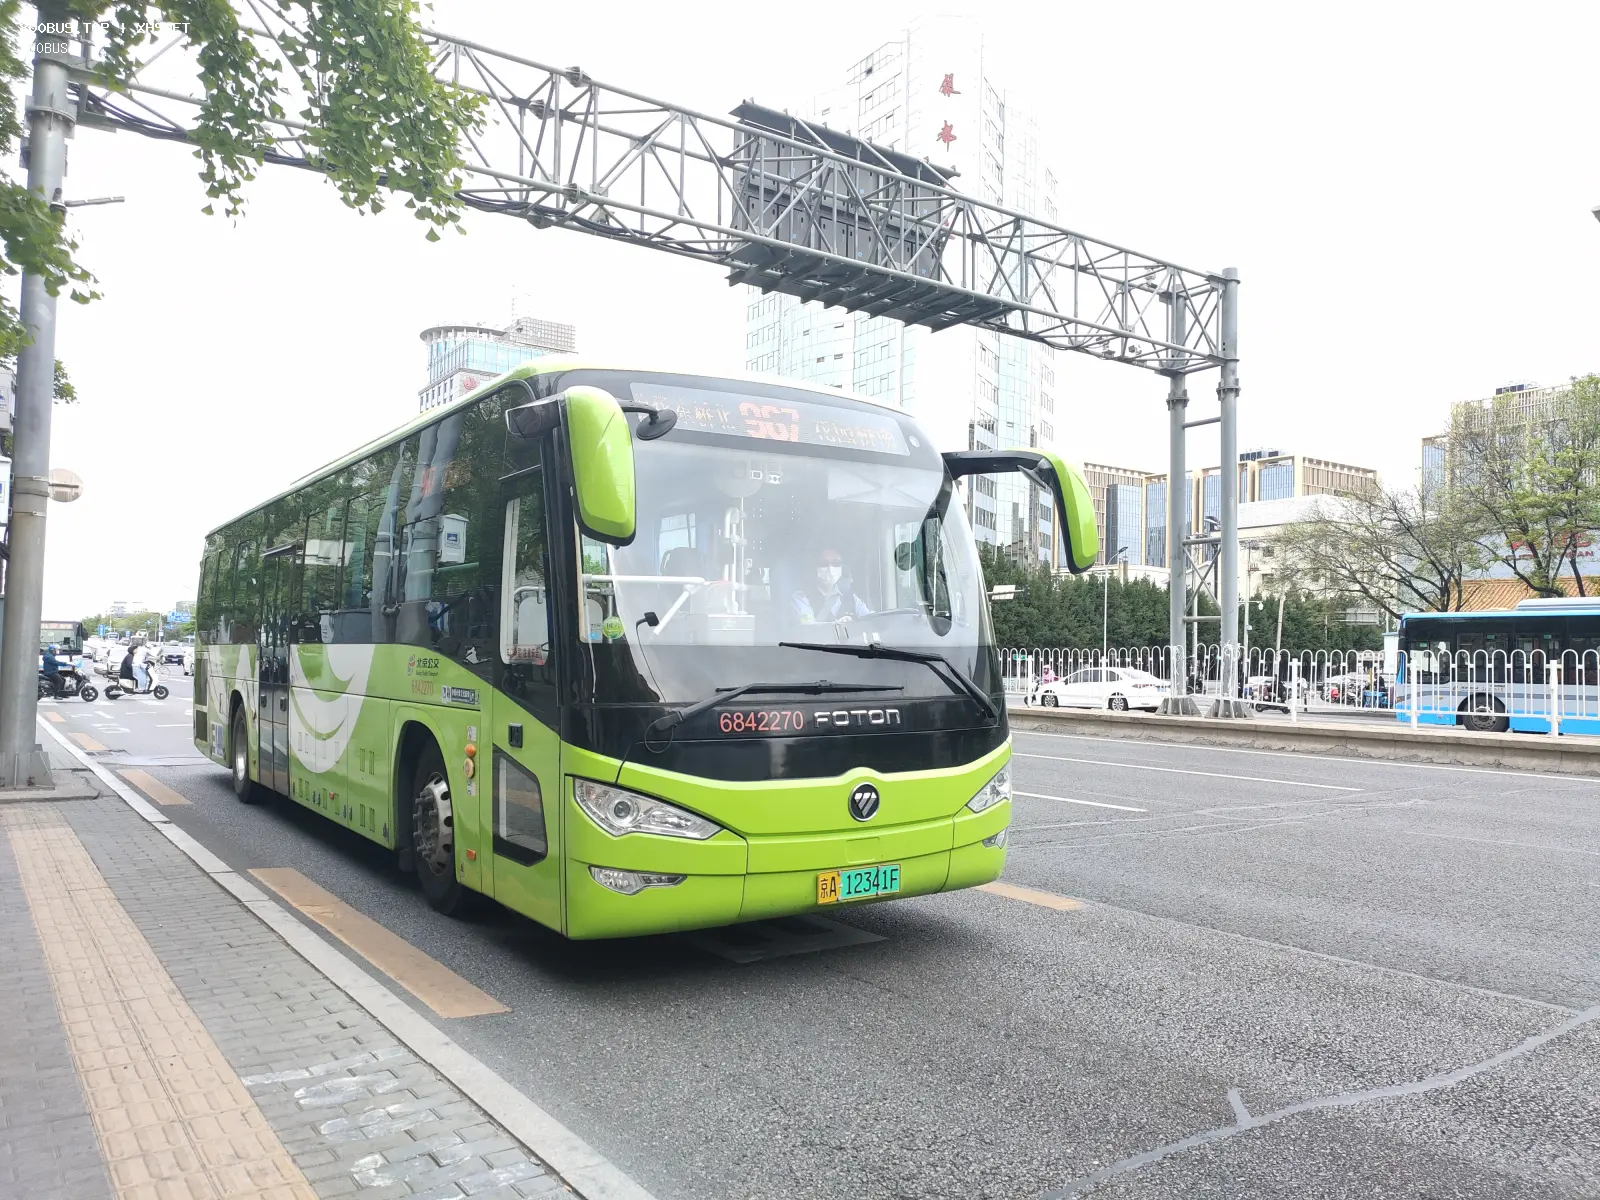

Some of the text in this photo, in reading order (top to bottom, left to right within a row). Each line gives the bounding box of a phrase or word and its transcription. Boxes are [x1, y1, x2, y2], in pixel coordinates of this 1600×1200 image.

[416, 658, 440, 669] 北京公交
[719, 711, 804, 732] 6842270
[813, 708, 901, 727] FOTON
[820, 868, 898, 898] 京A 12341F
